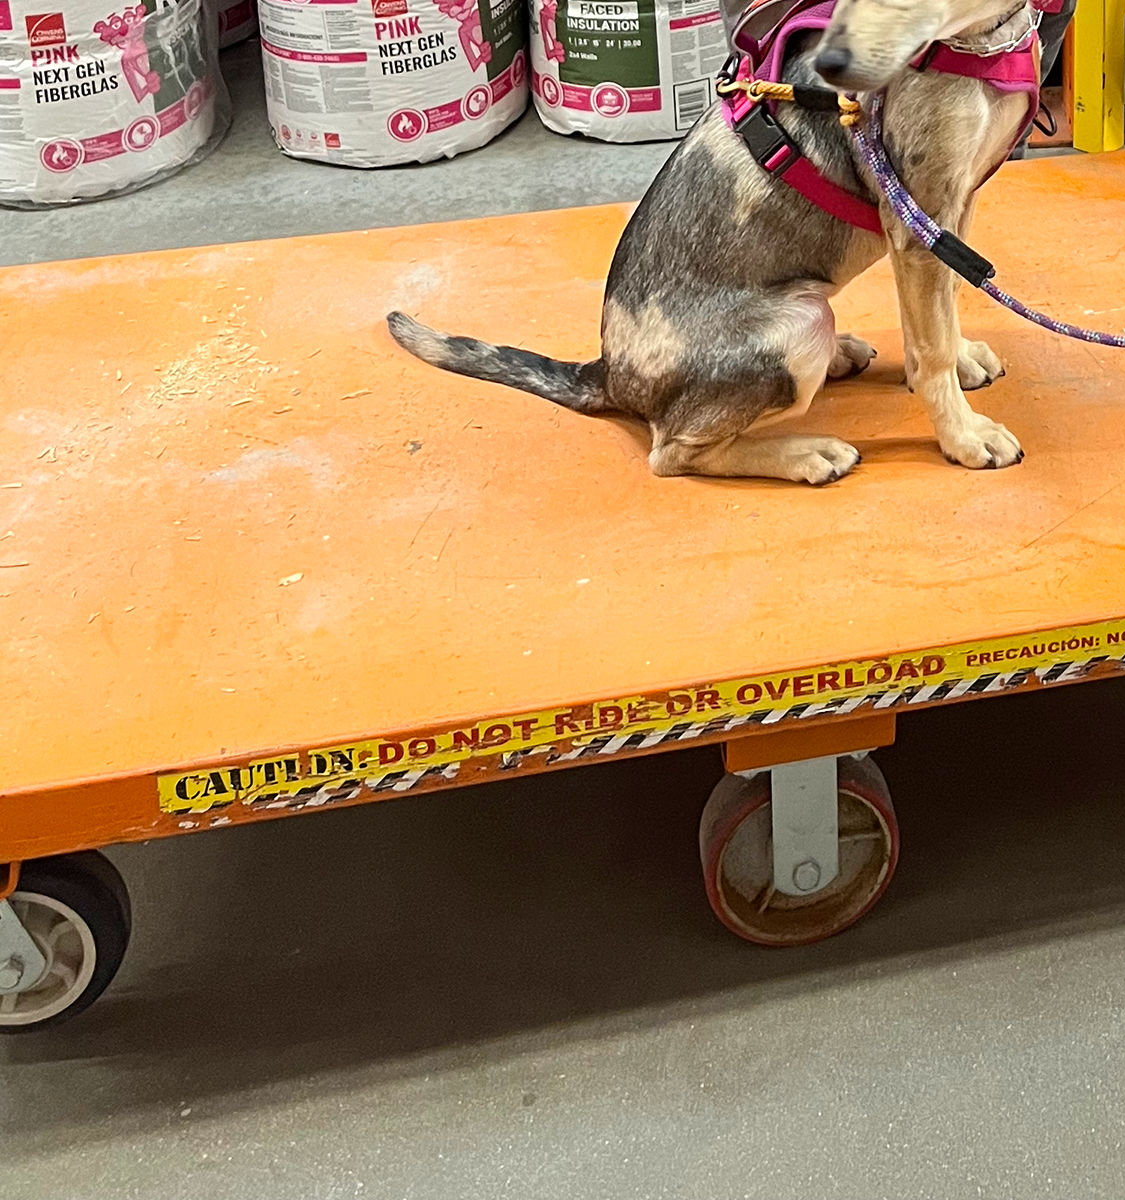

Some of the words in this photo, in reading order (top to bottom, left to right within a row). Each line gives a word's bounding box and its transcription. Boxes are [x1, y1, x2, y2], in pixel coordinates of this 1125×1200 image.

[580, 3, 624, 16] FACED
[374, 15, 423, 40] PINK
[566, 17, 640, 33] INSULATION
[30, 43, 80, 67] PINK
[378, 40, 415, 58] NEXT
[417, 31, 446, 50] GEN
[33, 66, 72, 86] NEXT
[75, 59, 107, 79] GEN
[381, 46, 458, 76] FIBERGLAS
[35, 74, 119, 104] FIBERGLAS
[966, 636, 1101, 667] PRECAUCIÓN:
[378, 737, 438, 765] DO
[453, 717, 539, 751] NOT
[554, 704, 651, 736] RIDE
[665, 690, 722, 716] OR
[735, 653, 947, 706] OVERLOAD
